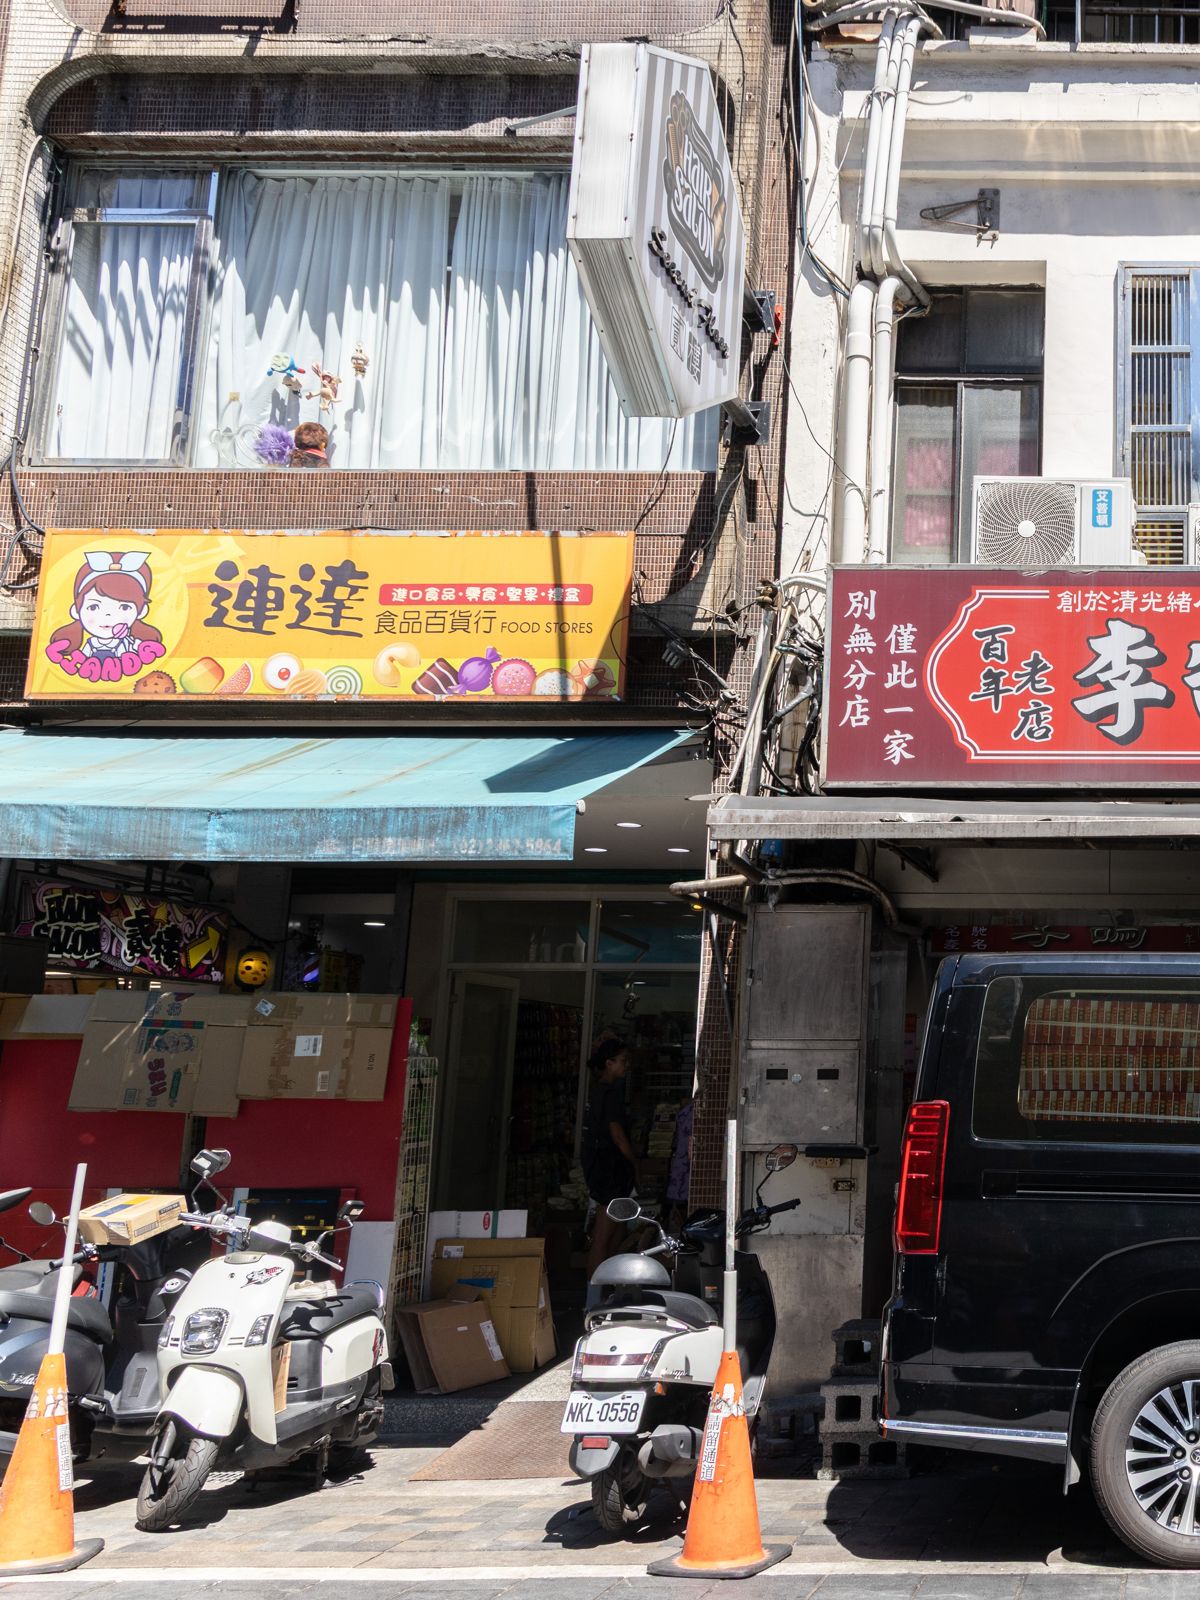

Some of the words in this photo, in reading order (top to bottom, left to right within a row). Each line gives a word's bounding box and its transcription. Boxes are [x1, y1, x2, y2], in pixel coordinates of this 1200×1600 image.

[1095, 489, 1111, 528] 艾普頓
[203, 559, 370, 638] 連達
[374, 609, 497, 634] 食品百貨行
[500, 621, 540, 634] FOOD
[544, 621, 593, 634] STORES
[838, 589, 878, 729] 別無分店
[882, 622, 919, 766] 僅此一家
[968, 623, 1017, 714] 百年
[1010, 650, 1056, 743] 老店
[565, 1402, 640, 1423] NKL-0558
